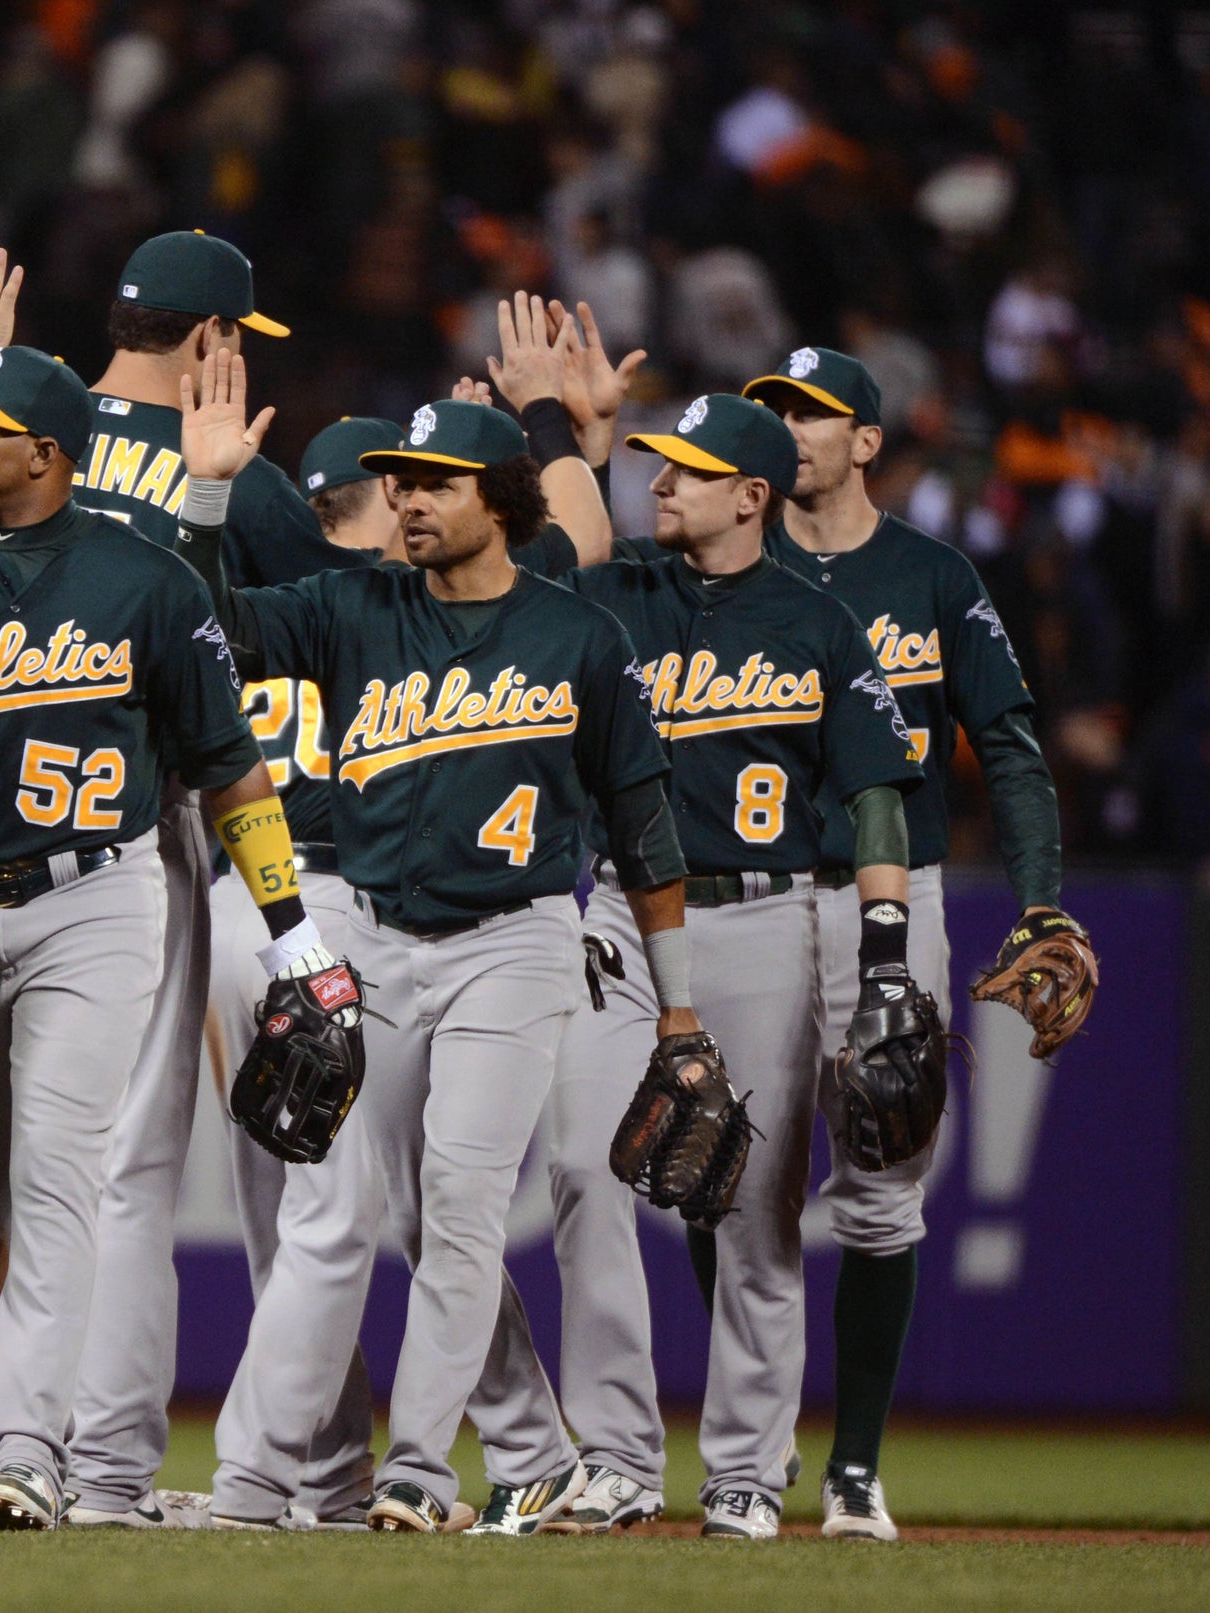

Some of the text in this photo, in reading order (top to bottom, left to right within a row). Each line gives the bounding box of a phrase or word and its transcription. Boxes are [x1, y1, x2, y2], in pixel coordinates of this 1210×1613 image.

[72, 432, 188, 519] IMA
[339, 665, 578, 760] Athletics
[15, 738, 126, 830] 52
[477, 784, 539, 867] 4
[734, 763, 788, 843] 8
[258, 859, 298, 894] 52
